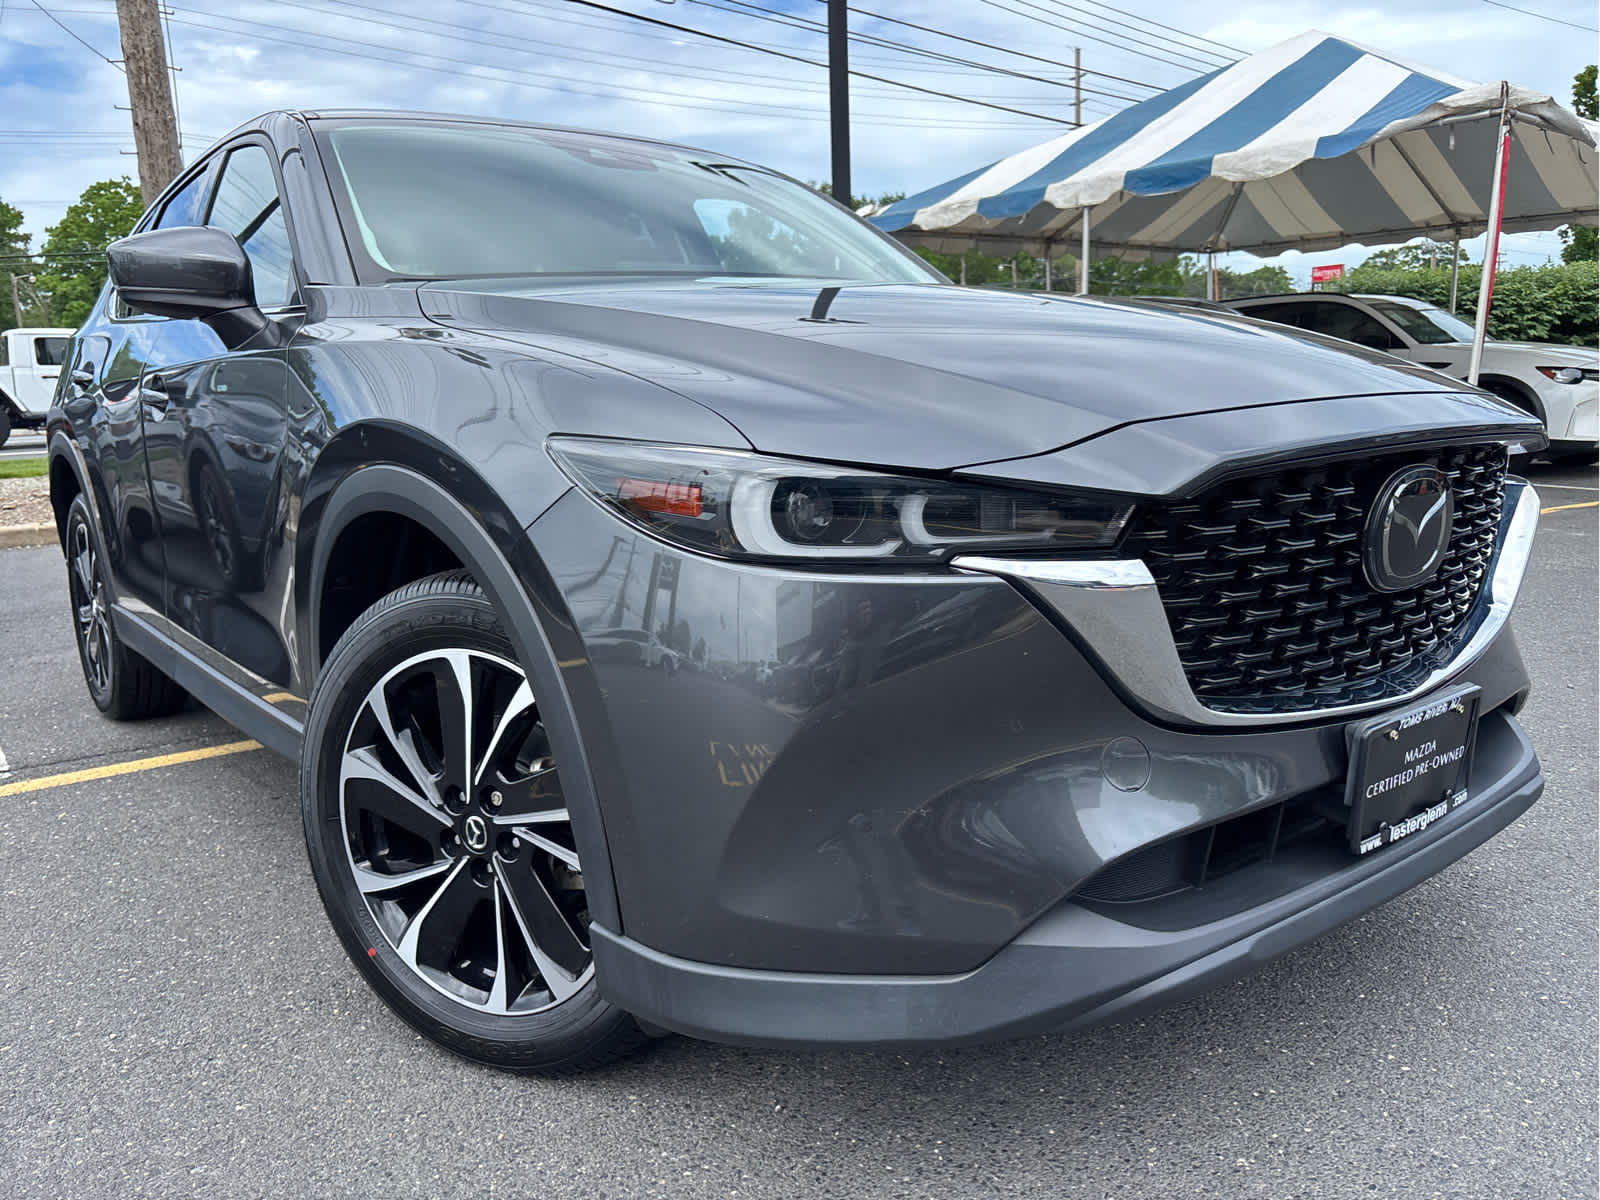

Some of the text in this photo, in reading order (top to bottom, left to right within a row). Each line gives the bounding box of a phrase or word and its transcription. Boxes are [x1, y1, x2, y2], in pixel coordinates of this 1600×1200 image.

[1398, 712, 1424, 730] TOMS
[1423, 703, 1448, 721] RIVER
[1404, 739, 1437, 765] MAZDA
[1366, 745, 1465, 799] CERTIFIED PRE-OWNED
